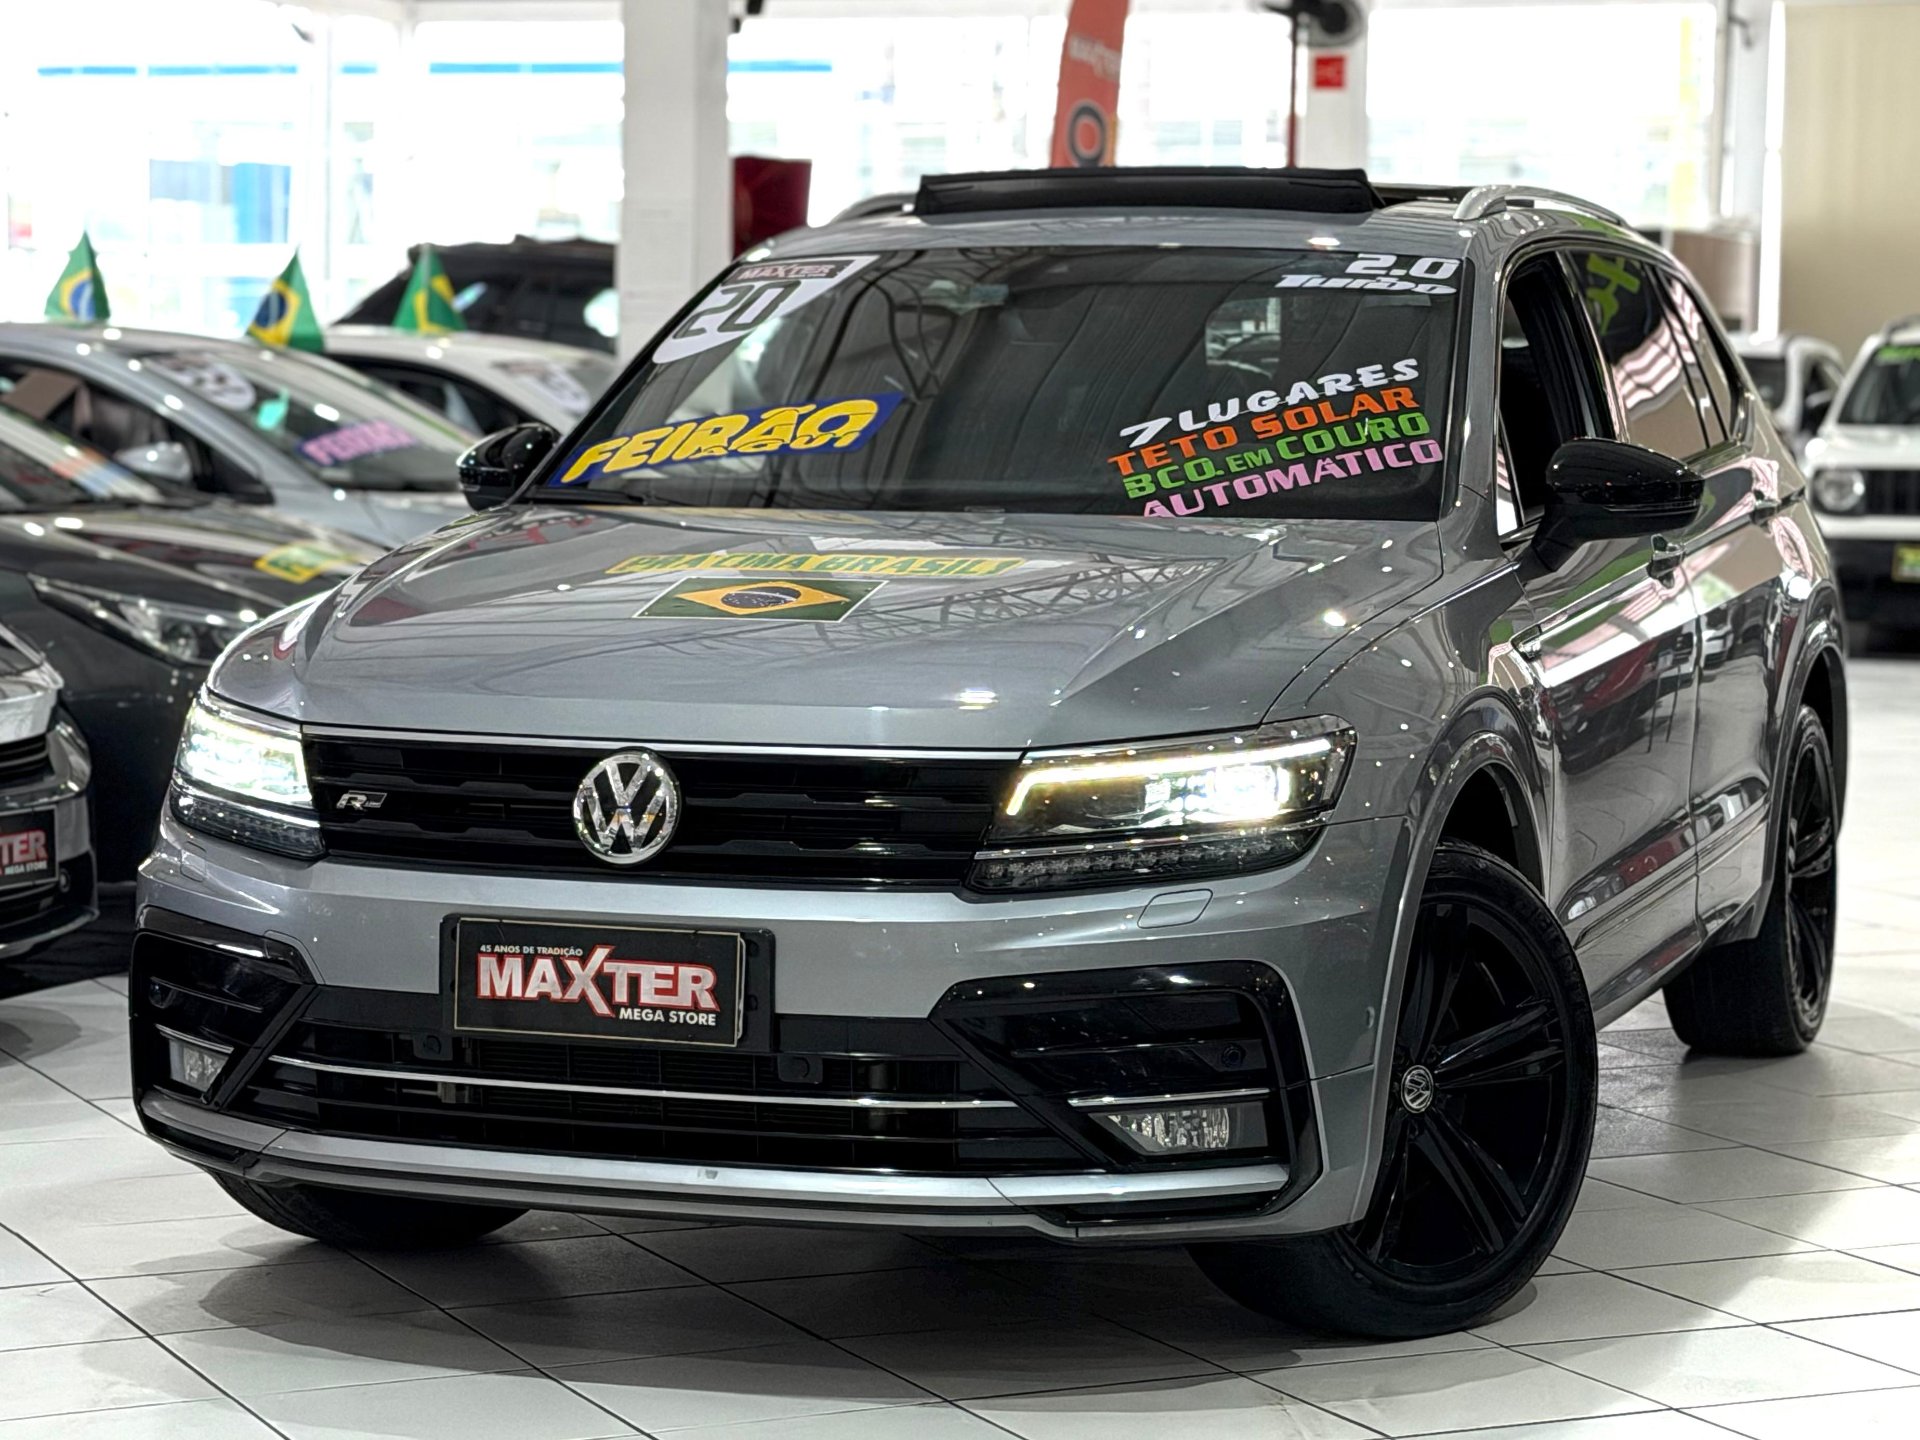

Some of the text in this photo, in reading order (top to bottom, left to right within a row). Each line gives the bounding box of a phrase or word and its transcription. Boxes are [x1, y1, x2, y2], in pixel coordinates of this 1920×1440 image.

[738, 264, 836, 280] MAXTER
[1345, 253, 1461, 280] 2.0
[672, 280, 801, 340] 20
[1107, 386, 1421, 477] TETO SOLAR
[1119, 358, 1420, 449] 7 LUGARES
[561, 399, 879, 484] FEIRÃO
[1122, 411, 1431, 499] BCO. EM COURO
[476, 944, 720, 1019] MAXTER
[480, 944, 584, 958] 45 ANOS DE TRADIÇÃO
[619, 1007, 717, 1027] MEGA STORE
